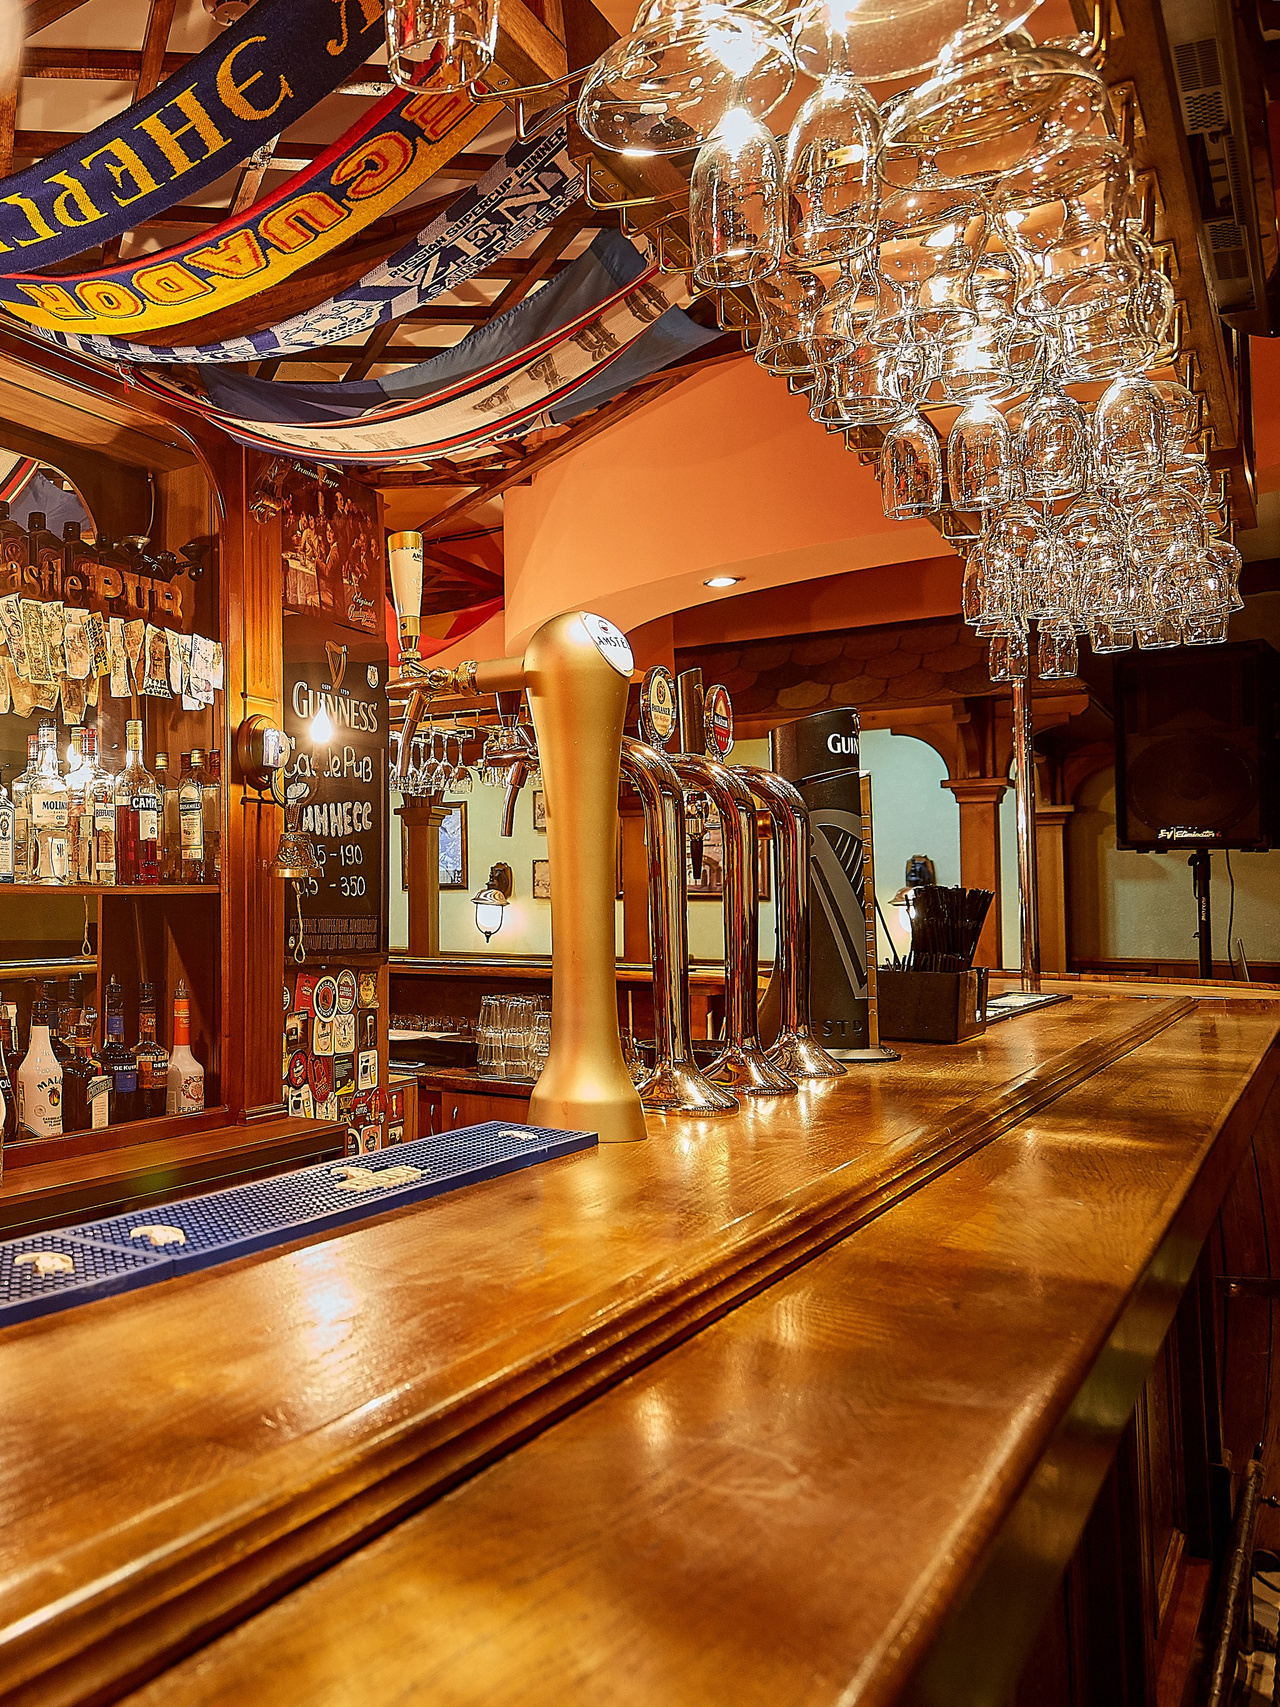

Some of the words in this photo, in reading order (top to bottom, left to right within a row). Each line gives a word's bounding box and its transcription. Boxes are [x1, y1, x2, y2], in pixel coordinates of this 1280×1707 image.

[16, 76, 477, 322] ECUADOR
[389, 236, 448, 279] RUSSIAN
[445, 177, 514, 239] SUPERCUP
[292, 461, 319, 482] Premium
[321, 473, 340, 489] Lager
[292, 681, 378, 733] GUINNESS
[302, 801, 373, 838] ИННЕСС
[340, 844, 363, 867] 190
[340, 875, 366, 897] 350
